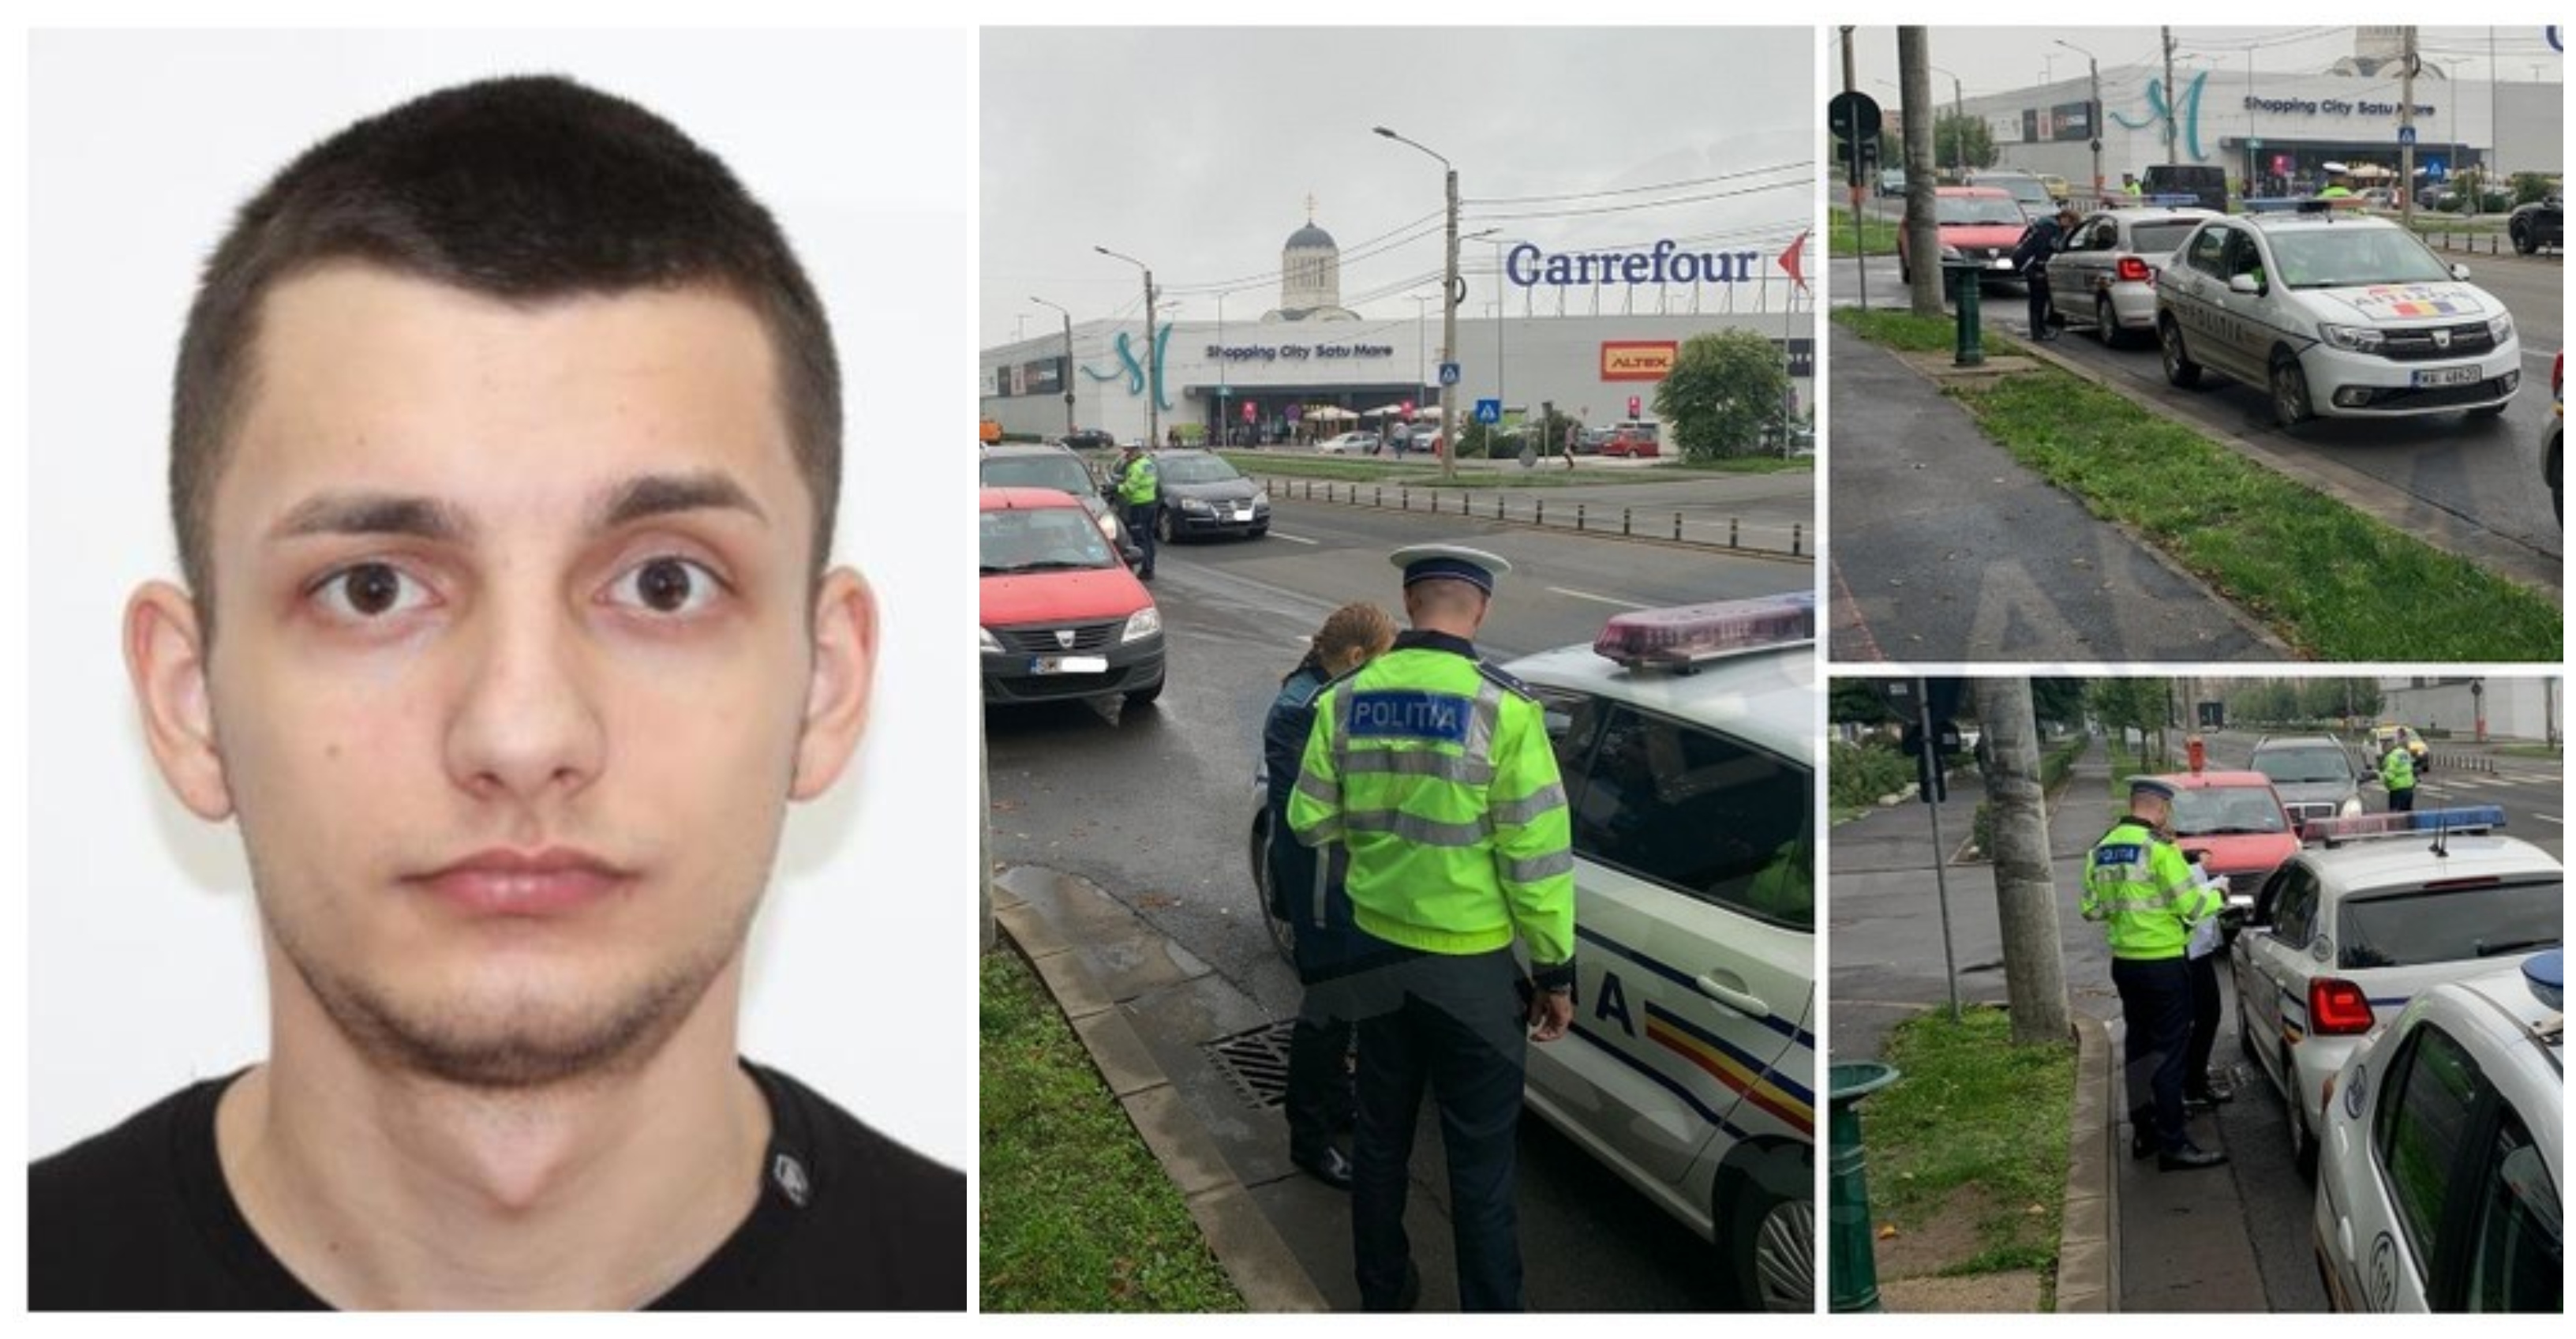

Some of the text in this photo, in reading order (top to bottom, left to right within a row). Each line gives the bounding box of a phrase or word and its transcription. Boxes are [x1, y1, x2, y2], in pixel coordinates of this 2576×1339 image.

[2245, 96, 2317, 116] Shopping
[2322, 99, 2353, 115] City
[2358, 100, 2392, 115] Satu
[1507, 239, 1758, 287] Carrefour
[1207, 344, 1394, 361] Shopping City Satu Mare
[1612, 356, 1668, 368] ALTEX
